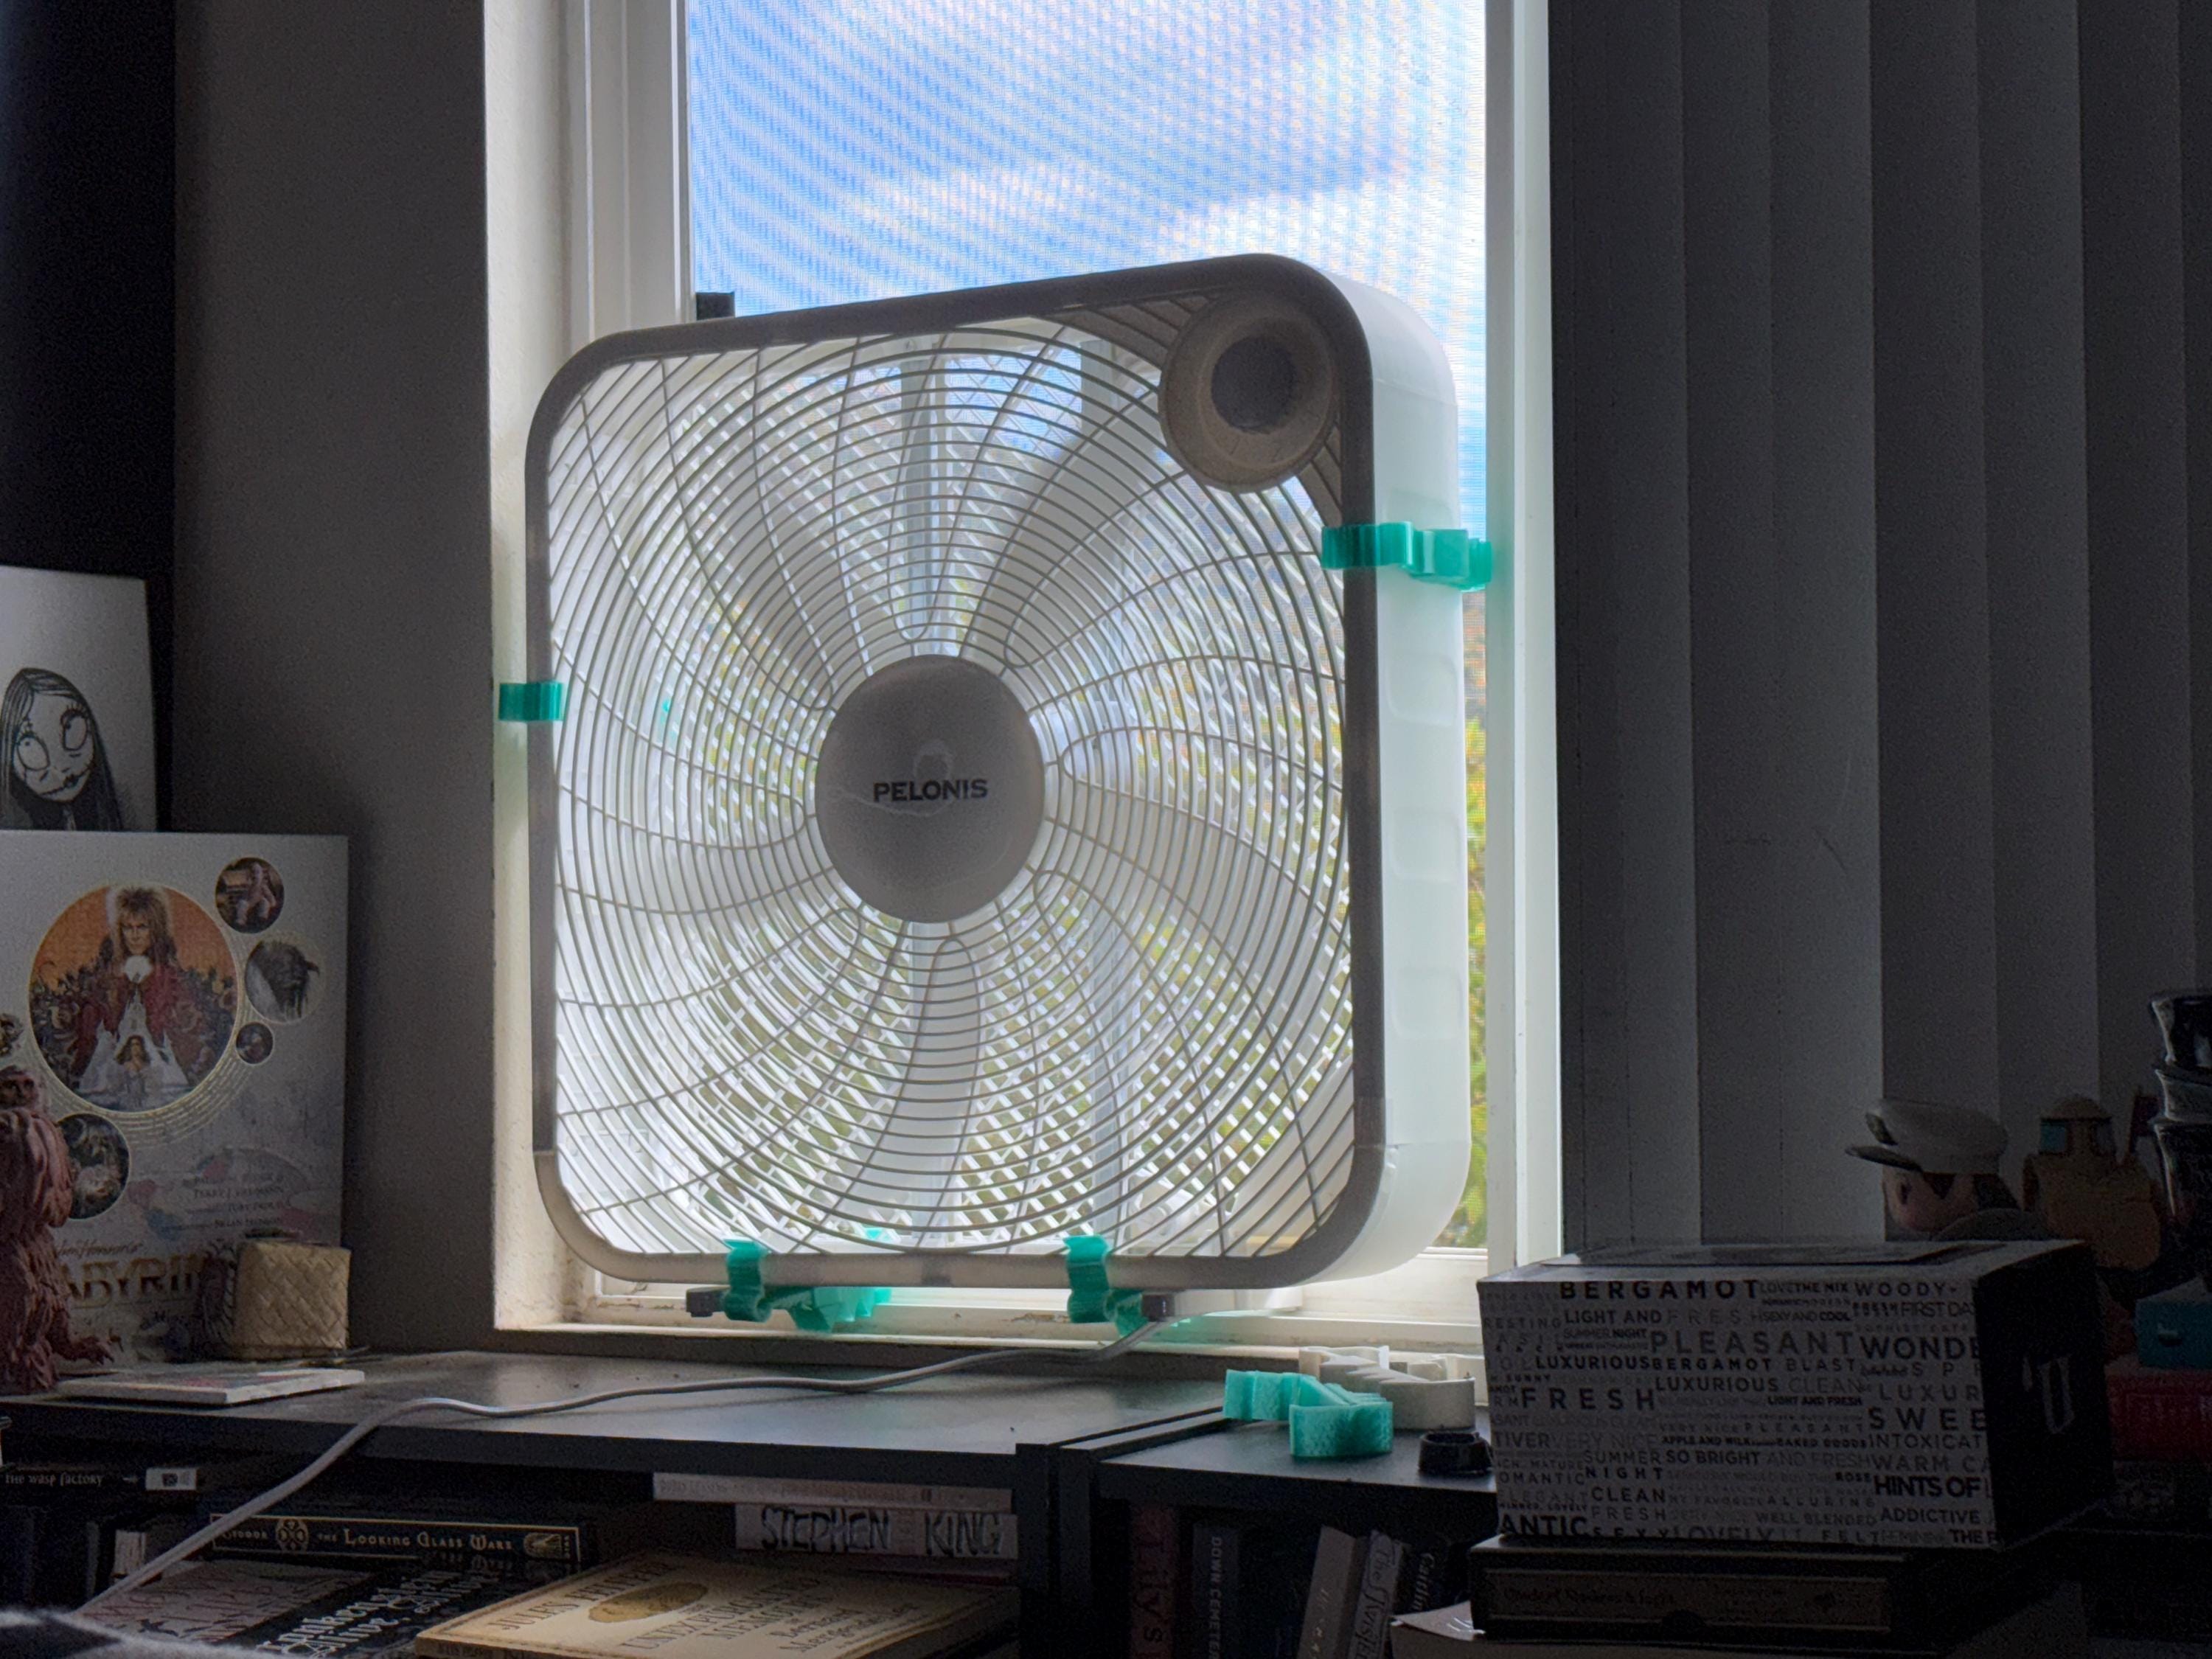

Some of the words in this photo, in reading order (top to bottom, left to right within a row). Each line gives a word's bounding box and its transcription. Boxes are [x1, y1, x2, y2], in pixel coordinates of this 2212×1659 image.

[874, 779, 988, 802] PELONIS
[1559, 1279, 1759, 1300] BERGAMOT
[1564, 1309, 1617, 1324] LIGHT
[1622, 1309, 1663, 1324] AND
[1819, 1310, 1851, 1322] COOL
[1612, 1328, 1647, 1338] NIGHT
[1651, 1330, 1854, 1355] PLEASANT
[1534, 1355, 1651, 1371] LUXURIOUS
[1652, 1357, 1773, 1371] BERGAMOT
[1786, 1357, 1855, 1371] BLAST
[1655, 1376, 1779, 1392] LUXURIOUS
[1788, 1377, 1863, 1394] CLEAN
[1879, 1383, 1980, 1402] LUXUR
[1520, 1386, 1655, 1411] FRESH
[1744, 1422, 1863, 1433] PLEASANT
[1868, 1406, 1987, 1431] SWEE
[1868, 1433, 1983, 1450] INTOXICAT
[1585, 1449, 1662, 1465] SUMMER
[1665, 1448, 1691, 1464] SO
[1695, 1449, 1761, 1467] BRIGHT
[1871, 1453, 1950, 1472] WARM
[1498, 1471, 1585, 1485] OMANTIC
[1585, 1466, 1664, 1481] NIGHT
[1590, 1485, 1666, 1503] CLEAN
[1873, 1474, 1943, 1498] HINTS
[1944, 1475, 1981, 1498] OF
[1590, 1506, 1667, 1522] FRESH
[1881, 1506, 1981, 1525] ADDICTIVE
[762, 1506, 889, 1554] STEPHEN
[925, 1512, 1001, 1559] KING
[1501, 1513, 1587, 1537] ANTIC
[1950, 1528, 1983, 1544] THE
[1210, 1534, 1224, 1584] DOWN
